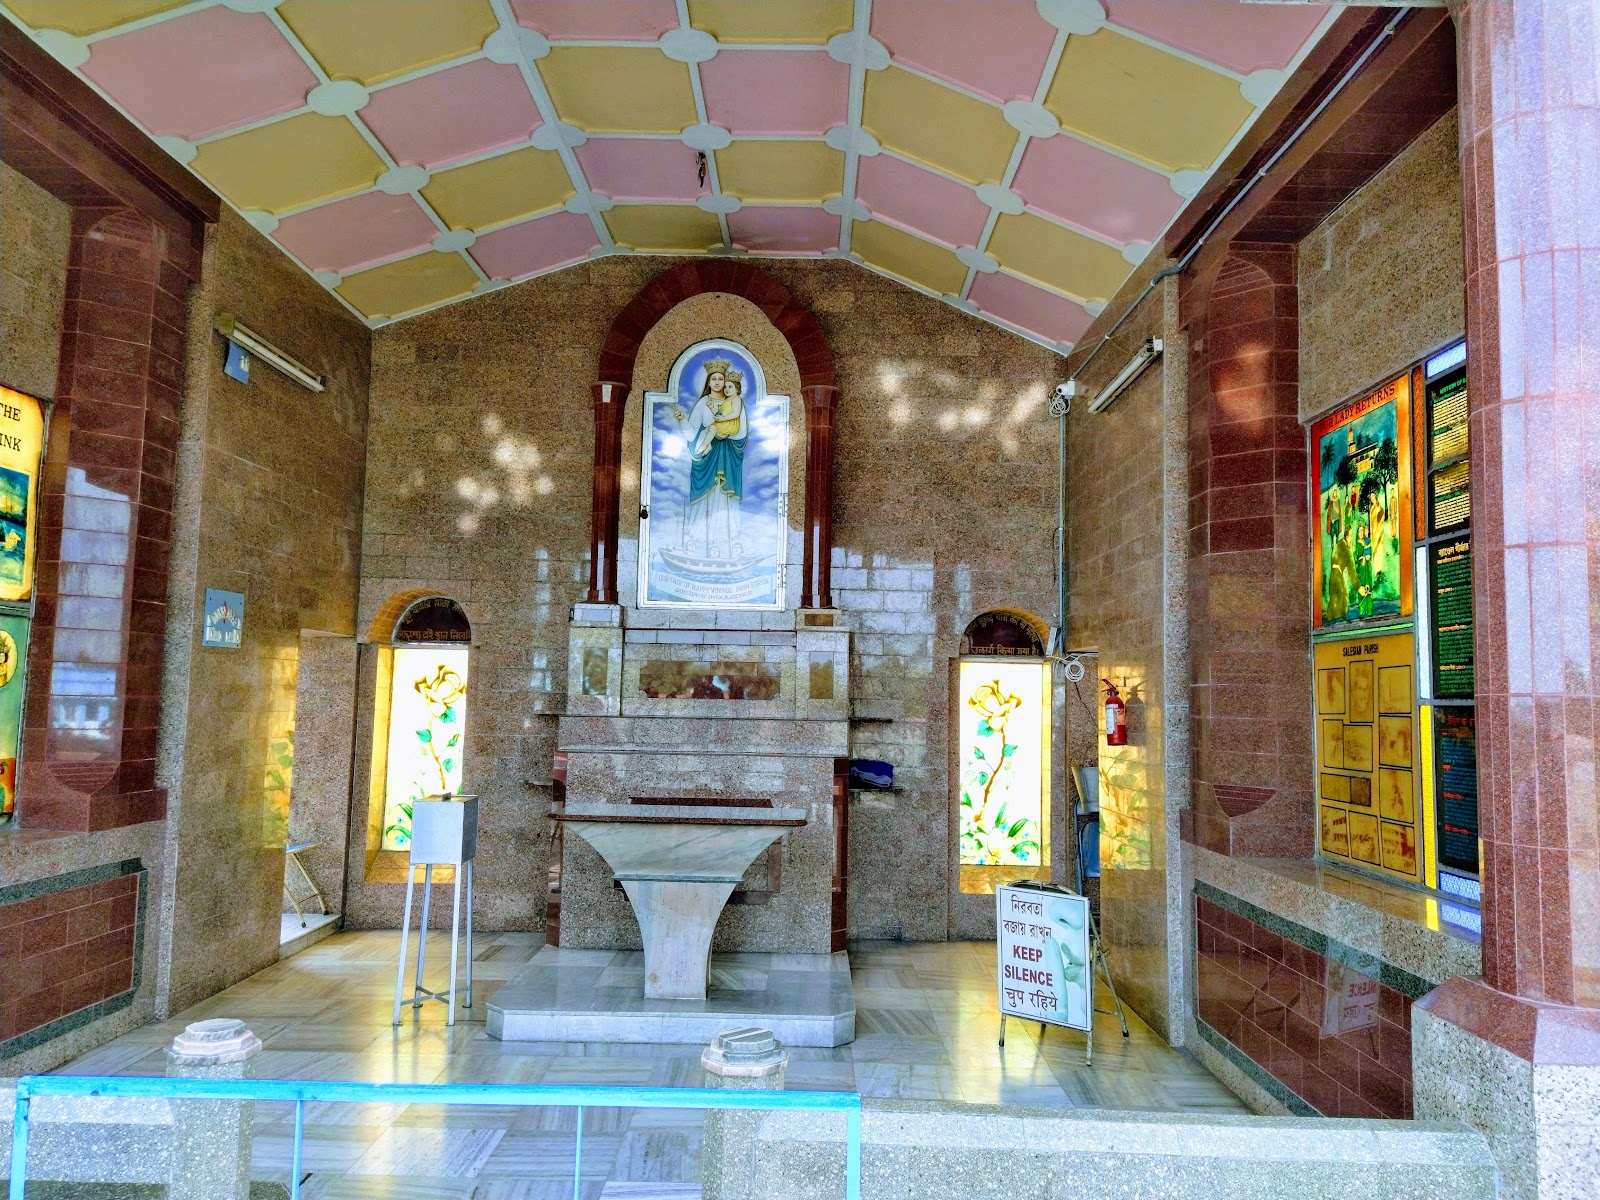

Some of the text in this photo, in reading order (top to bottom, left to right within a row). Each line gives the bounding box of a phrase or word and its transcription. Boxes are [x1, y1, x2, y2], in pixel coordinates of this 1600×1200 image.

[1334, 405, 1355, 427] LADY
[1355, 383, 1395, 414] RETURNS
[670, 577, 684, 586] LADY
[691, 584, 711, 593] HAPPY
[736, 583, 750, 592] PRAY
[751, 579, 762, 588] FOR
[996, 643, 1015, 655] किया
[1016, 647, 1030, 656] गया
[1364, 643, 1379, 654] PARISH
[1010, 894, 1043, 917] নিরবতা
[1003, 919, 1052, 944] বজায় রাখুন
[1012, 944, 1043, 963] KEEP
[1004, 964, 1053, 987] SILENCE
[1005, 987, 1058, 1011] चुप रहिये
